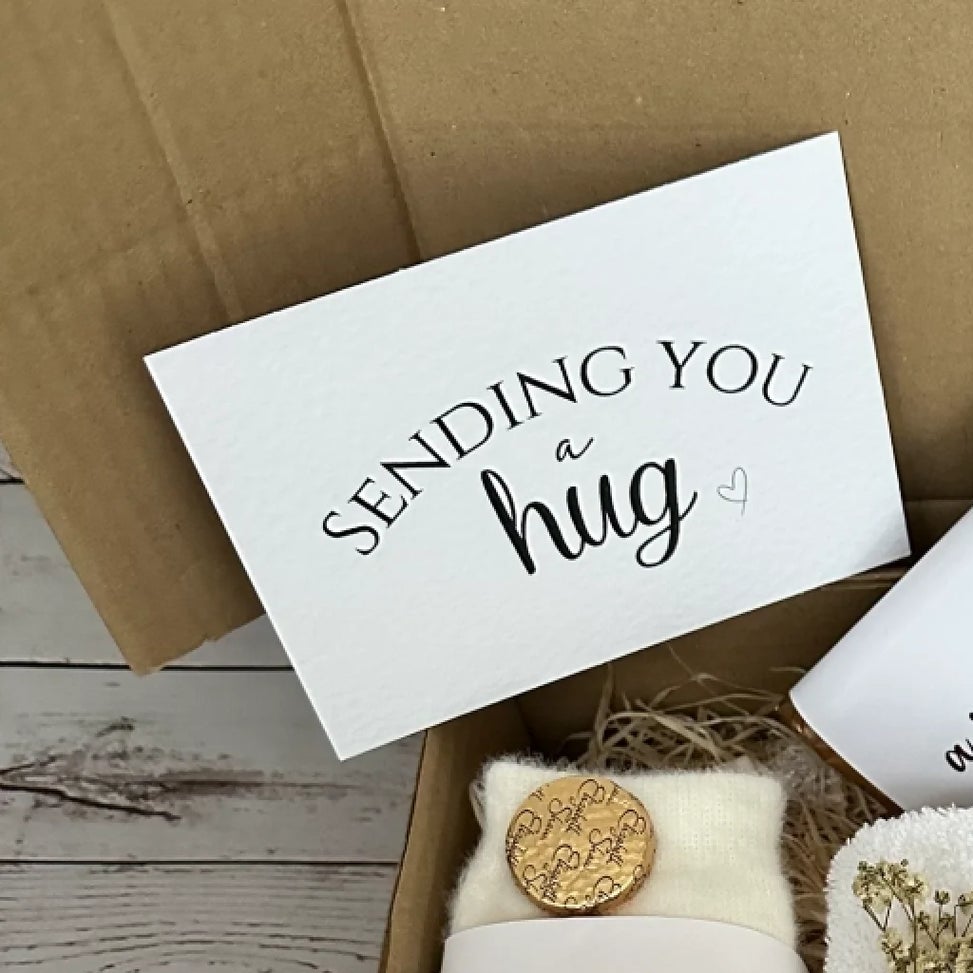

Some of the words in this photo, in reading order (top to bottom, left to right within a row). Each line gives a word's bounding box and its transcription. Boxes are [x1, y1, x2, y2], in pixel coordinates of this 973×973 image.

[322, 345, 636, 557] SENDING
[656, 340, 813, 408] YOU
[556, 437, 594, 463] a
[480, 457, 699, 576] hug
